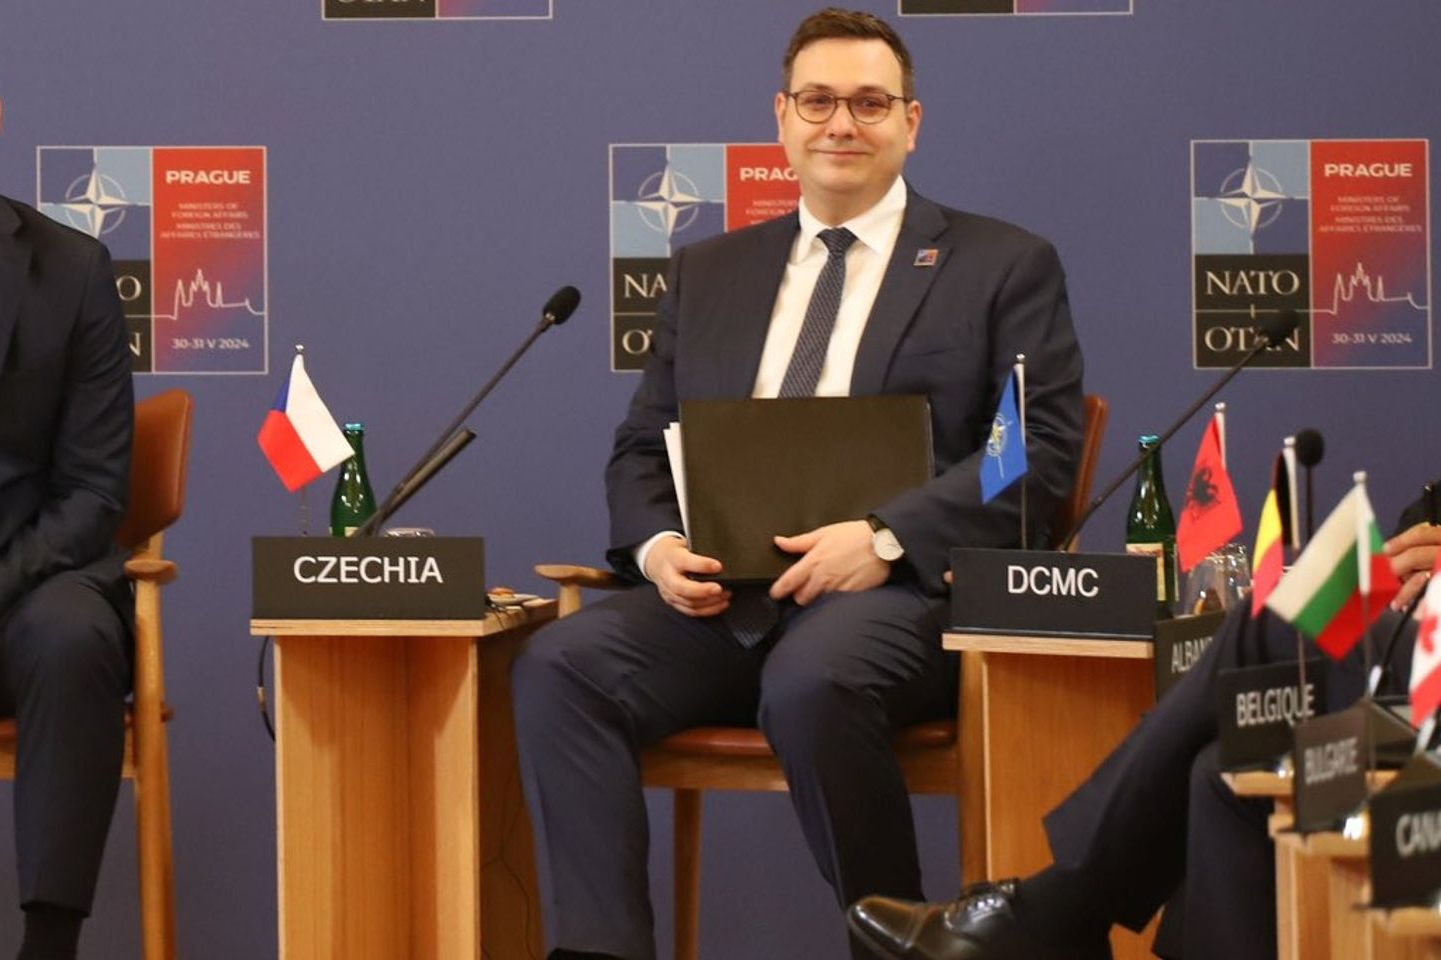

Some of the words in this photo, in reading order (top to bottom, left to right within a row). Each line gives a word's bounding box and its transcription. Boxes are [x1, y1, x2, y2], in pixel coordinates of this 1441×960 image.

[165, 170, 251, 184] PRAGUE
[739, 167, 798, 180] PRAG
[1324, 163, 1412, 177] PRAGUE
[624, 273, 667, 299] NA
[1205, 270, 1299, 294] NATO
[172, 338, 204, 348] 30-31
[206, 338, 216, 348] V
[218, 338, 249, 348] 2024
[1204, 326, 1300, 351] OTN
[1332, 333, 1365, 343] 30-31
[1367, 333, 1377, 343] V
[1379, 333, 1412, 343] 2024
[293, 556, 443, 583] CZECHIA
[1008, 565, 1099, 597] DCMC
[1236, 683, 1315, 727] BELGIQUE
